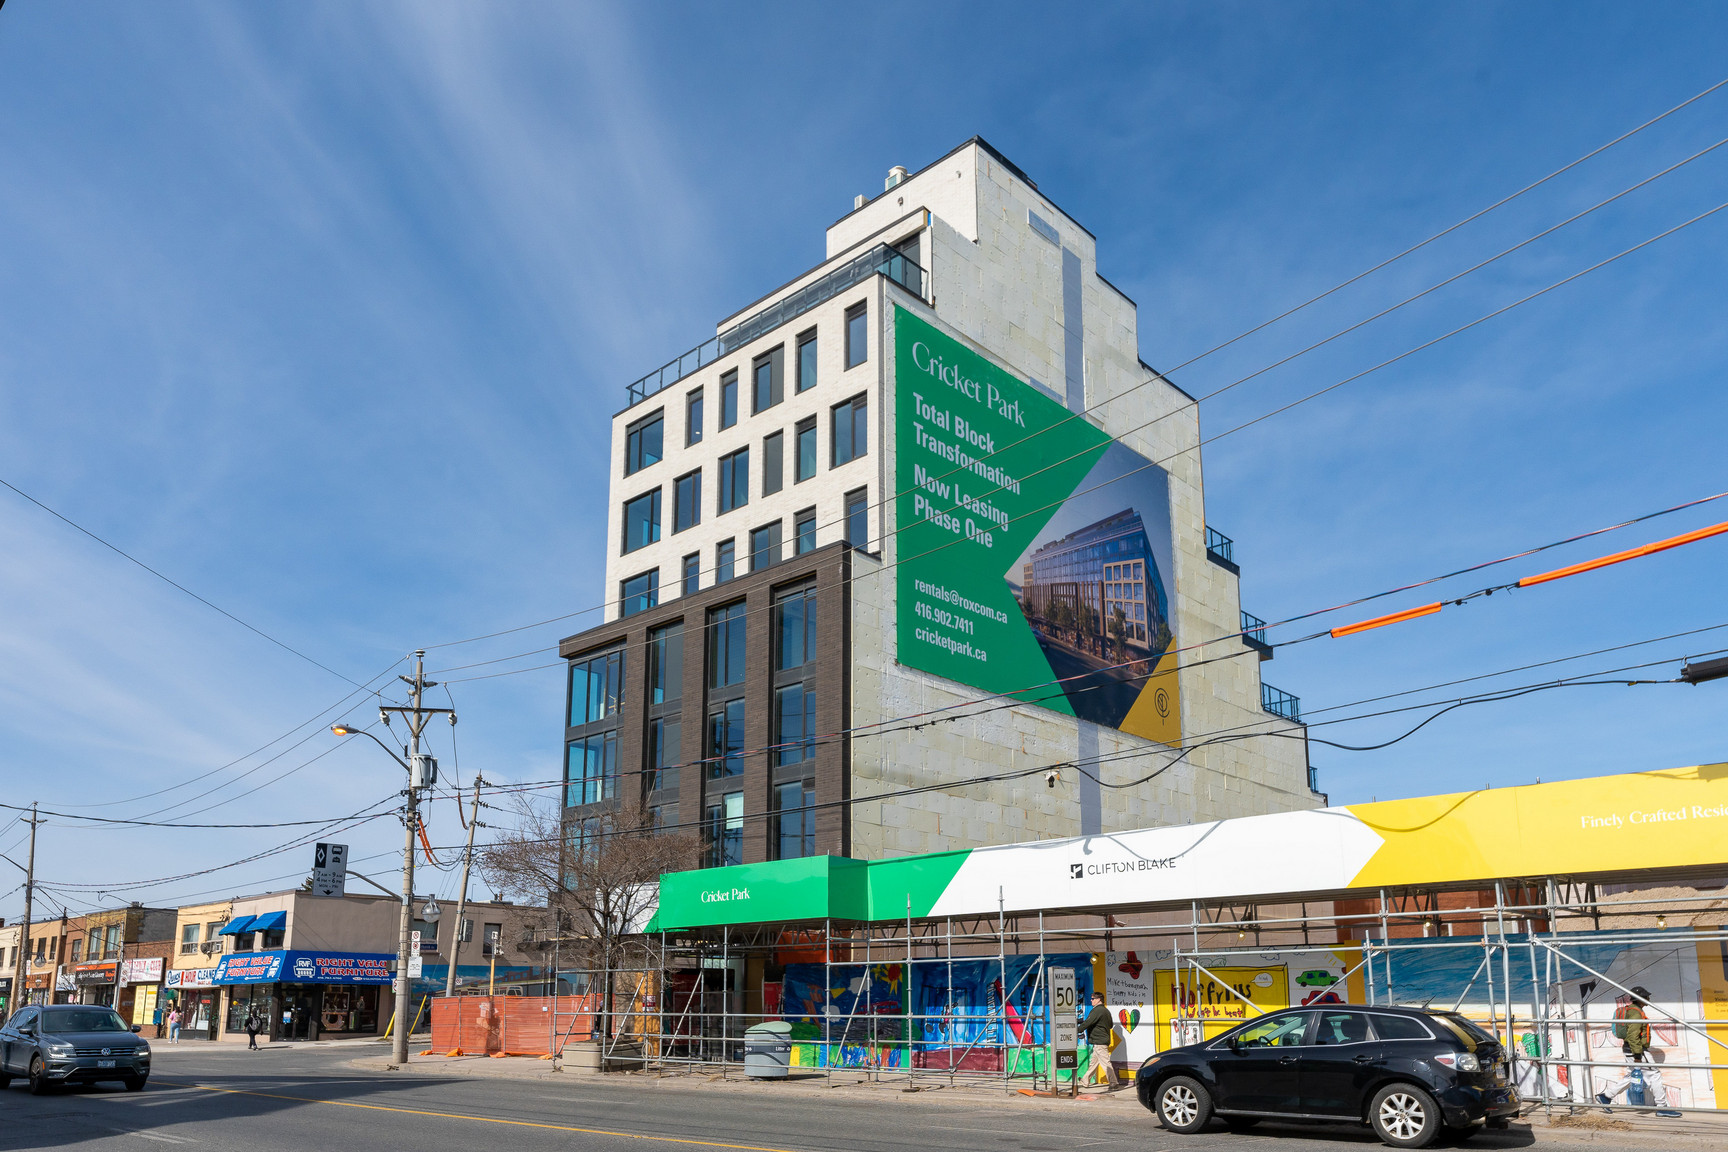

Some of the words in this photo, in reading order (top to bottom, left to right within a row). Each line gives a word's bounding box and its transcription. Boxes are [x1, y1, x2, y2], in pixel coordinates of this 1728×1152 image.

[912, 341, 981, 403] Cricket
[987, 382, 1025, 428] Park
[913, 391, 949, 431] Total
[955, 415, 994, 455] Block
[913, 421, 1020, 495] Transformation
[914, 463, 950, 500] Now
[955, 483, 1008, 532] Leasing
[914, 493, 960, 534] Phase
[965, 517, 993, 548] One
[914, 578, 1008, 624] rentals@roxcom.ca
[914, 601, 974, 635] 416.902.7411
[915, 627, 987, 662] cricketpark.ca
[1581, 813, 1625, 829] Finely
[1629, 806, 1687, 824] Crafted
[1087, 861, 1135, 876] CLIFTON
[1138, 857, 1176, 871] BLAKE
[701, 890, 730, 904] Cricket
[732, 888, 750, 900] Park
[225, 966, 266, 978] FURNITURE
[228, 958, 250, 968] RIGHT
[250, 956, 274, 966] VALUE
[316, 958, 354, 966] RIGHT
[357, 959, 388, 968] VALU
[321, 967, 390, 976] FURNITURE
[198, 970, 216, 980] CLEANE
[1056, 986, 1074, 1006] 50
[1060, 1034, 1072, 1042] ZONE
[1060, 1056, 1074, 1064] ENDS
